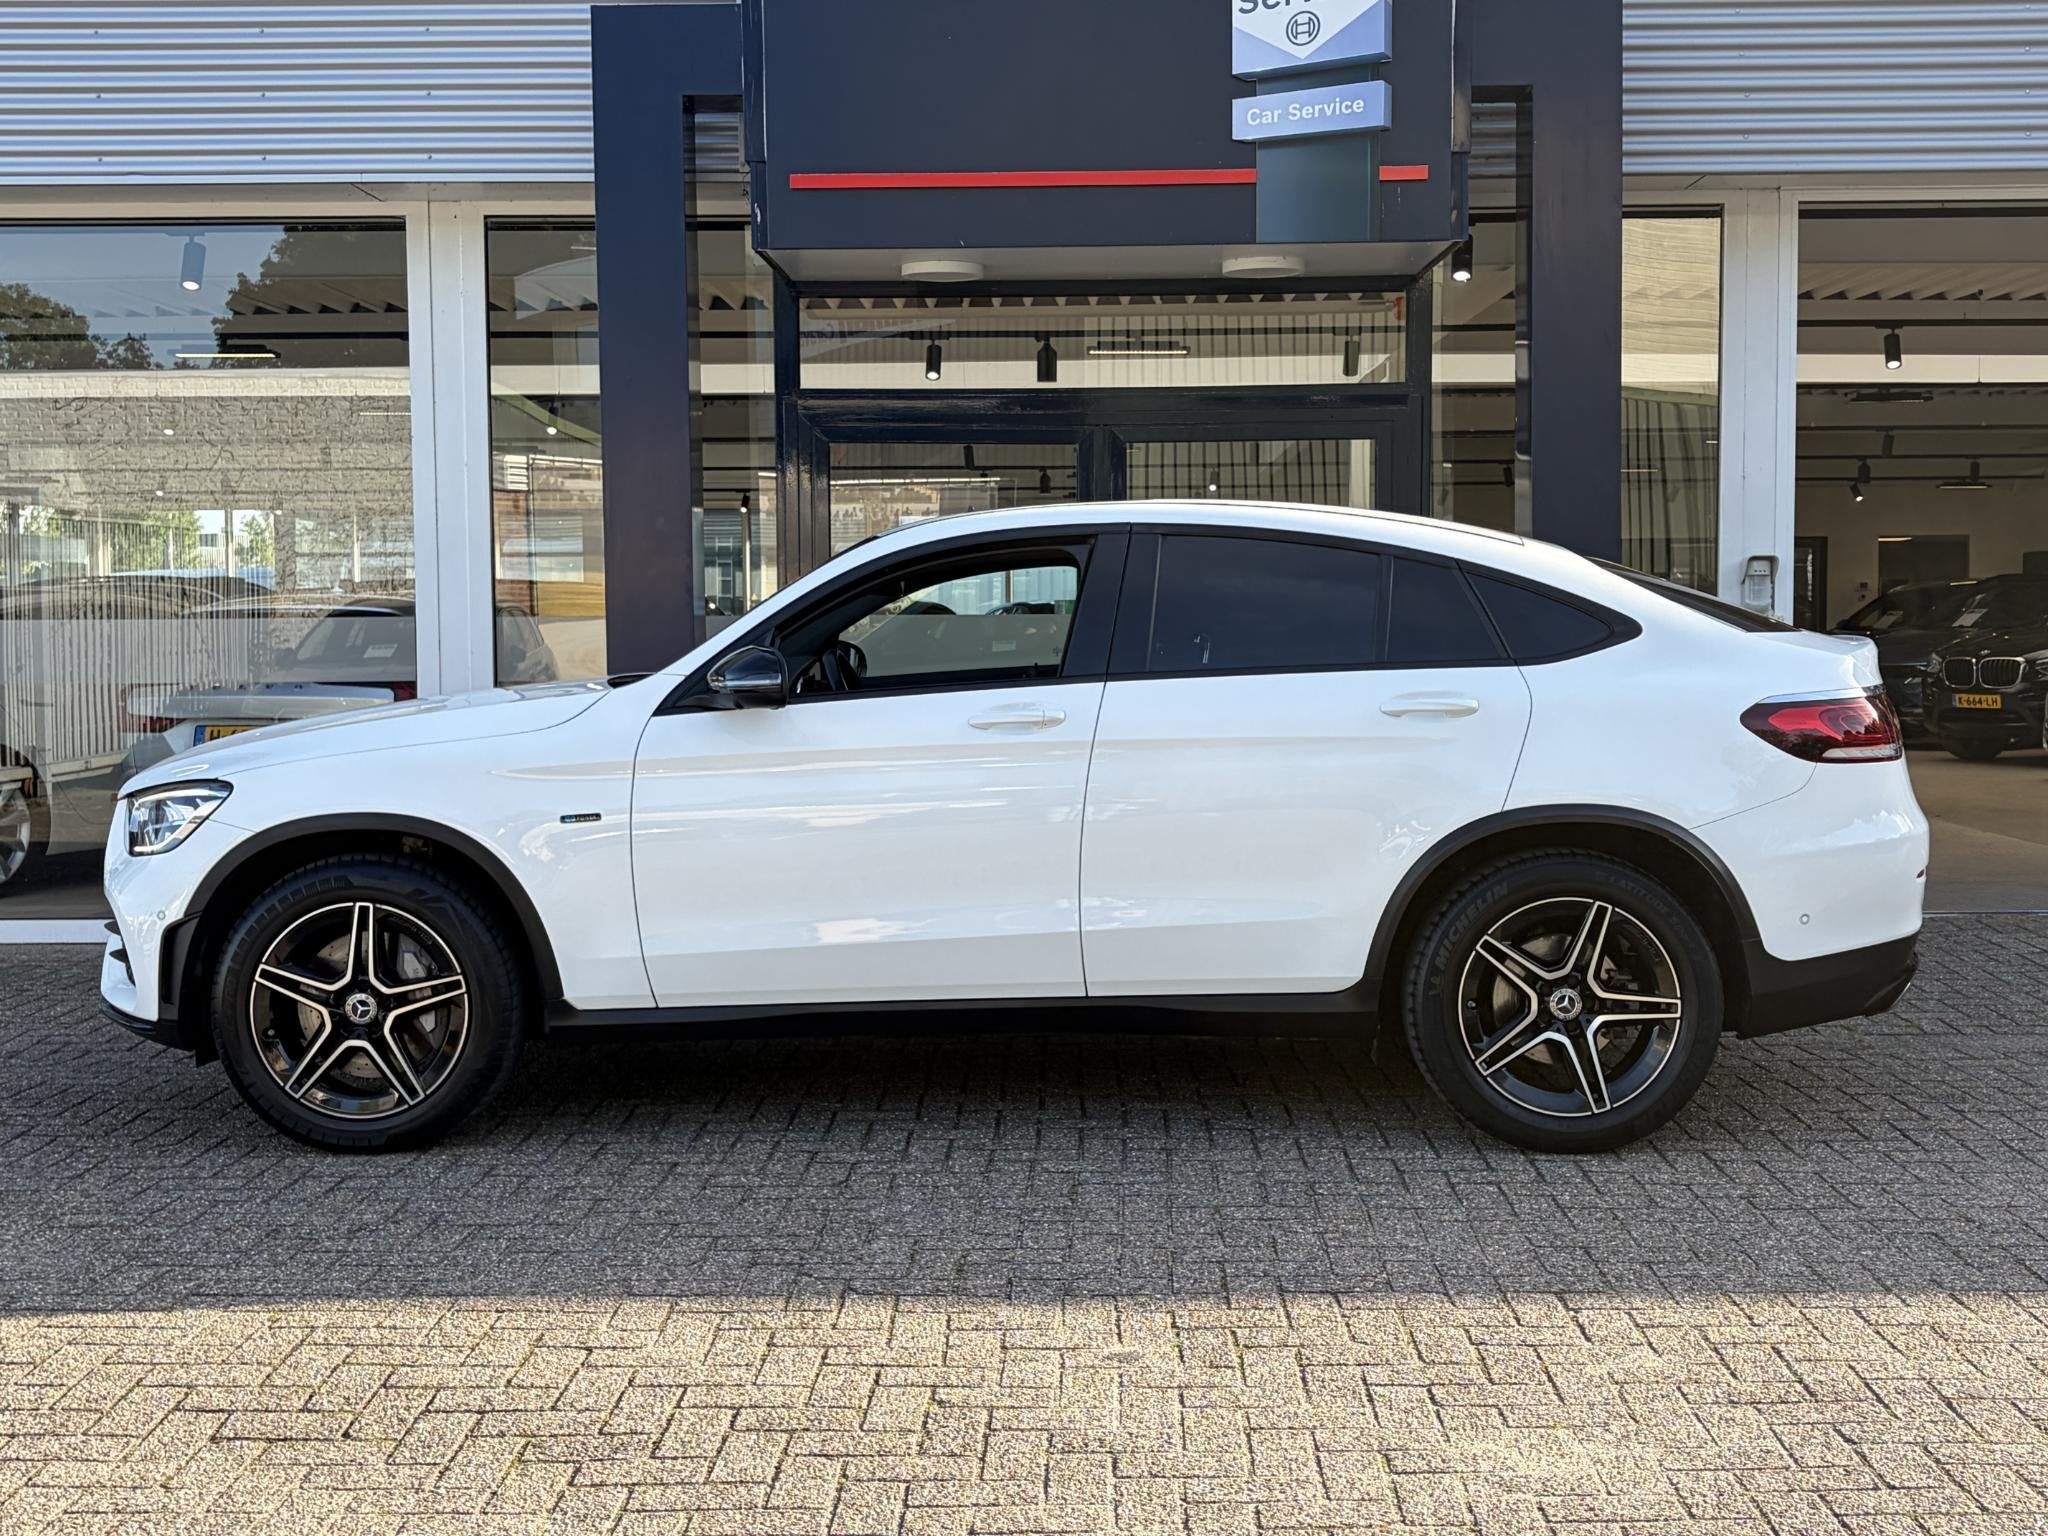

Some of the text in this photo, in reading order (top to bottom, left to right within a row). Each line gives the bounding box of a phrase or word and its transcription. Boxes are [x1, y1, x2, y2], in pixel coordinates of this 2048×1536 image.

[1246, 97, 1365, 126] Car Service
[1957, 696, 1999, 707] K-664-LH
[1434, 880, 1510, 971] MICHELIN
